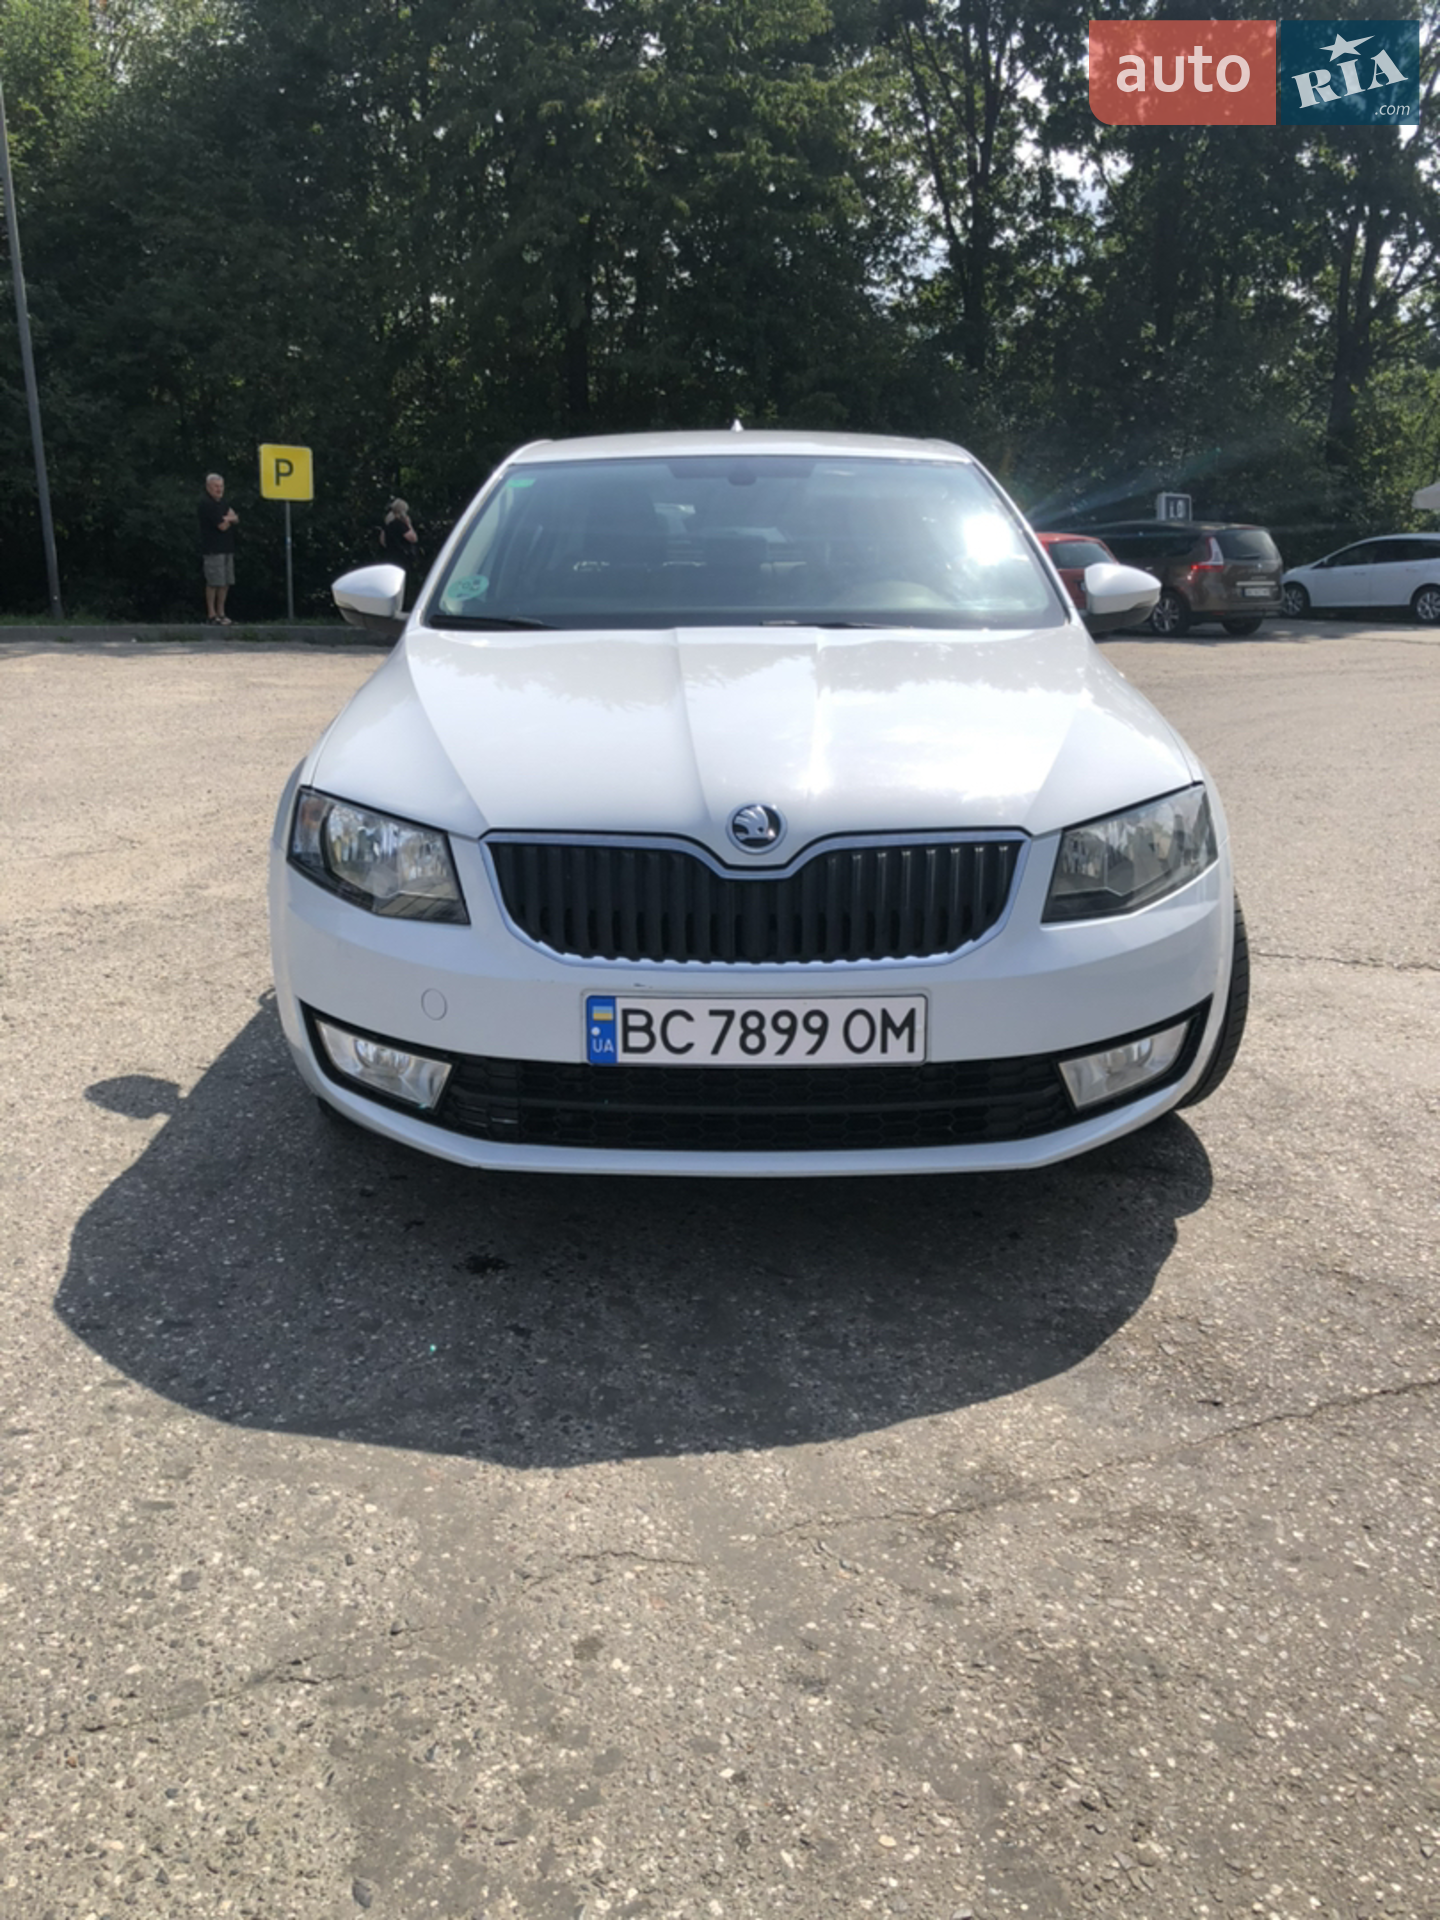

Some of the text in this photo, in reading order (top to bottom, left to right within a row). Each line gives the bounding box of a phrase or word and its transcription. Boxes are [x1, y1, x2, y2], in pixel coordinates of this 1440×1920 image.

[274, 458, 294, 486] P
[593, 1038, 615, 1053] UA
[621, 1007, 916, 1056] BC 7899 OM
